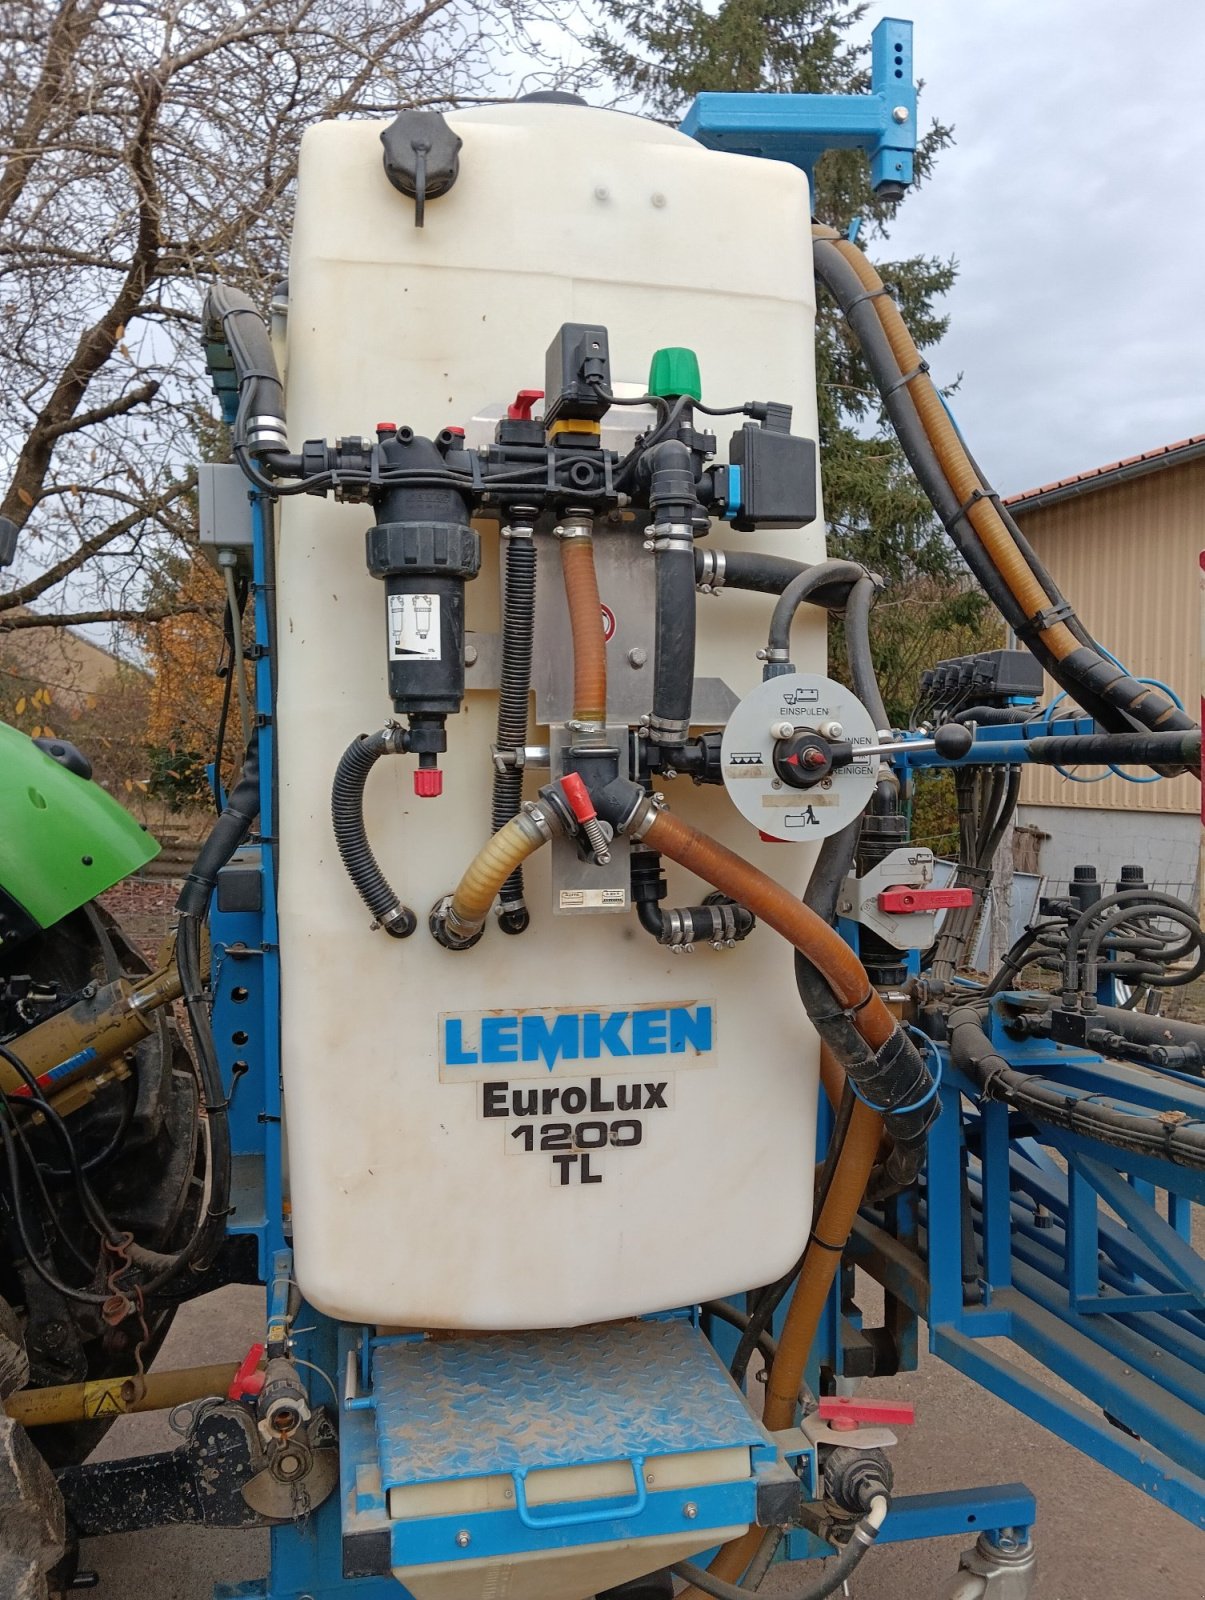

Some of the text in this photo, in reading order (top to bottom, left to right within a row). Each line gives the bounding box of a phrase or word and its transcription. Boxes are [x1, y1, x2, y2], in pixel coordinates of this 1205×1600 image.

[445, 1006, 712, 1073] LEMKEN
[483, 1077, 668, 1118] EuroLux
[511, 1119, 643, 1152] 1200
[552, 1153, 602, 1186] TL
